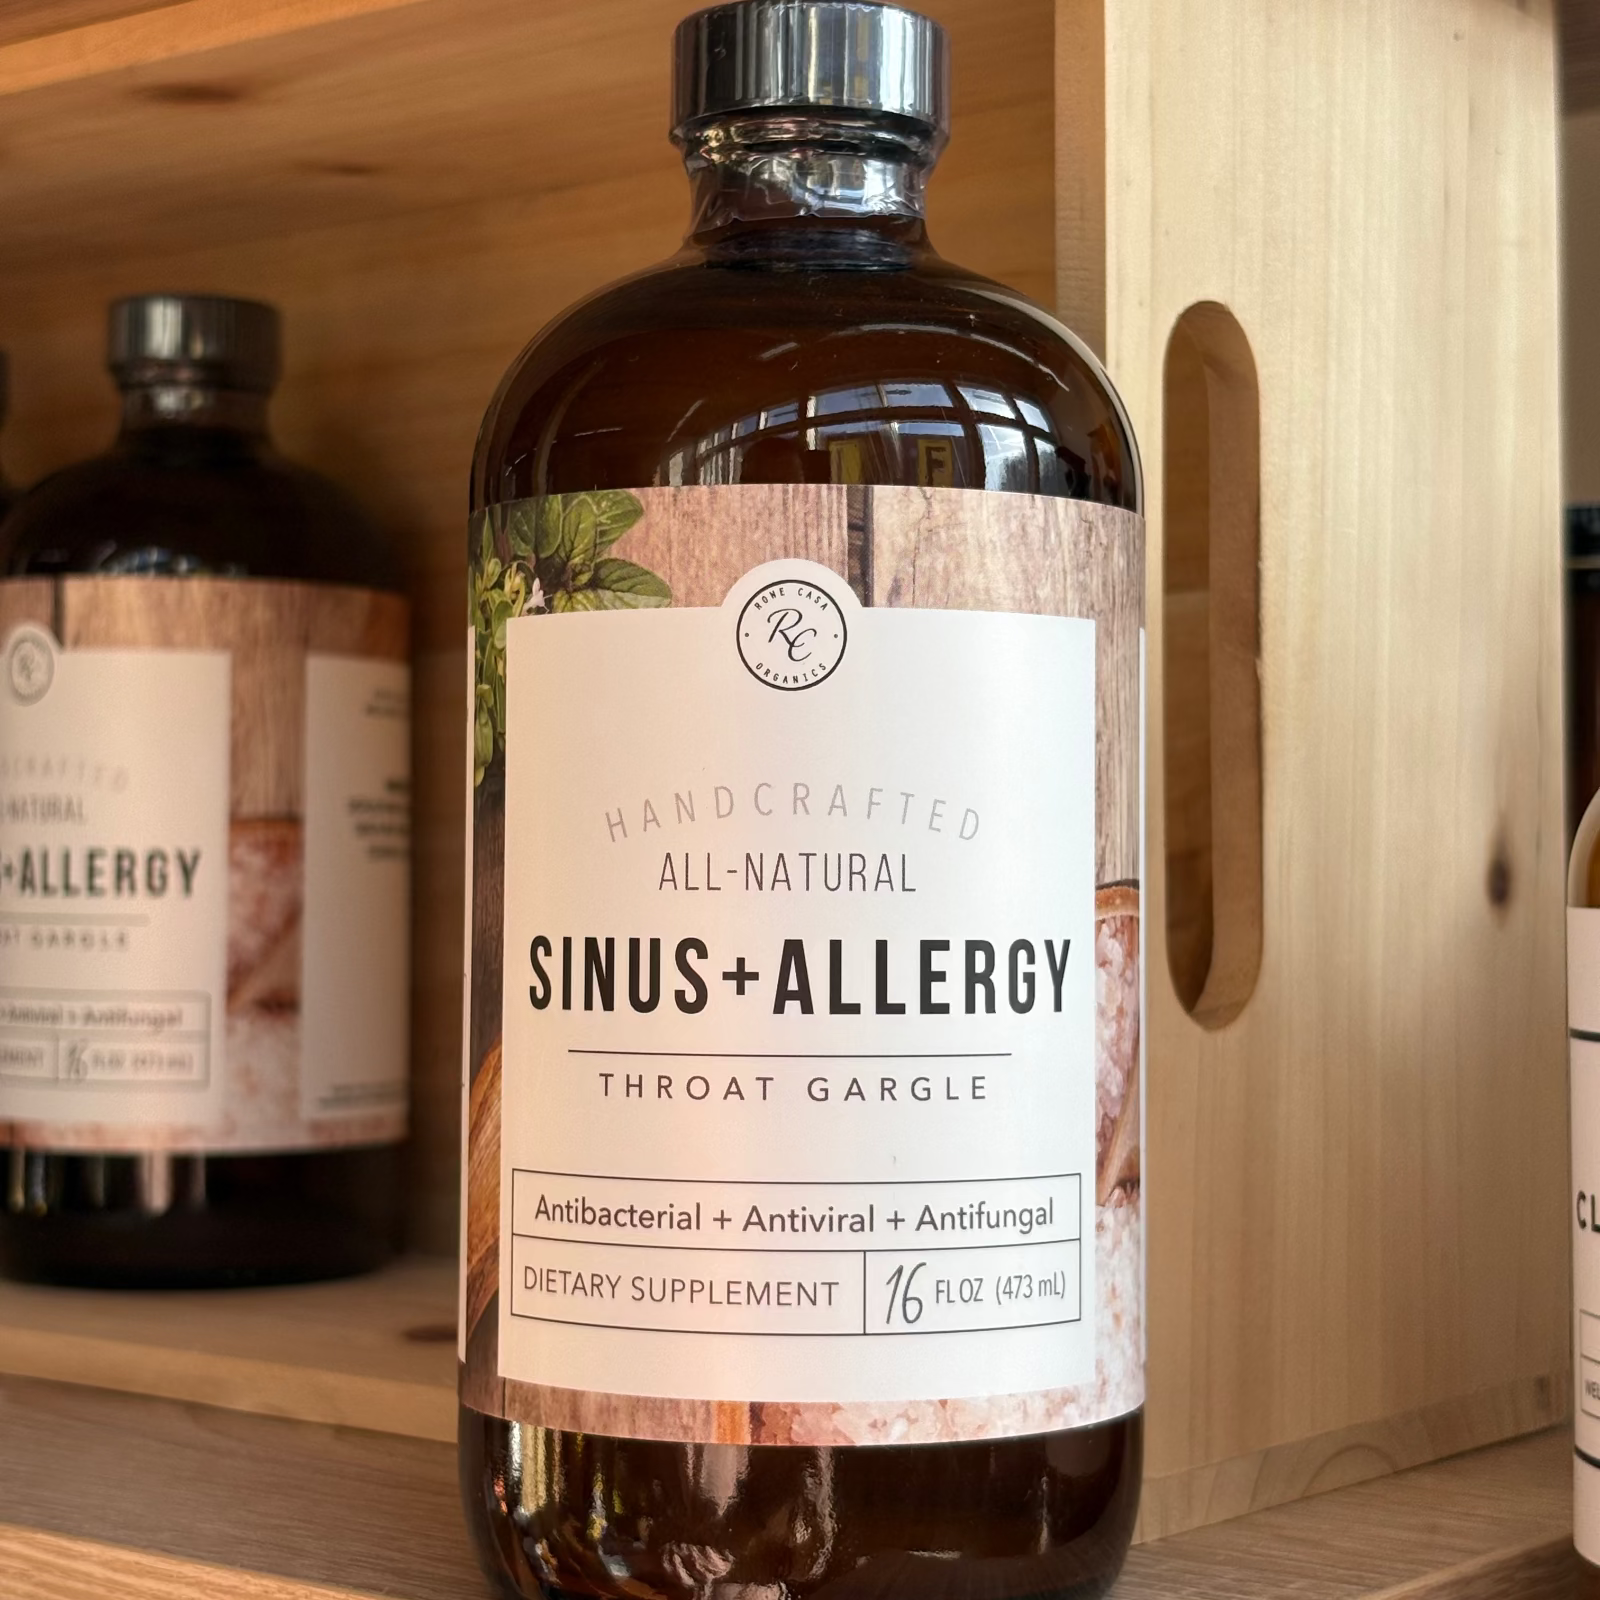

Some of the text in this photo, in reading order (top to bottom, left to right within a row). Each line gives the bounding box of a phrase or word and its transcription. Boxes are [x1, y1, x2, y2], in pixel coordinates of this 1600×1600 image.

[797, 587, 828, 611] CASA
[755, 662, 827, 685] ORGANICS
[605, 782, 980, 843] HANDCRAFTED
[658, 851, 917, 893] ALL-NATURAL
[598, 1072, 989, 1103] THROAT GARGLE
[535, 1193, 1053, 1236] Antibacterial + Antiviral + Antifungal
[523, 1265, 839, 1307] DIETARY SUPPLEMENT
[886, 1261, 927, 1325] 16
[995, 1273, 1033, 1306] (473
[1038, 1270, 1066, 1300] mL)
